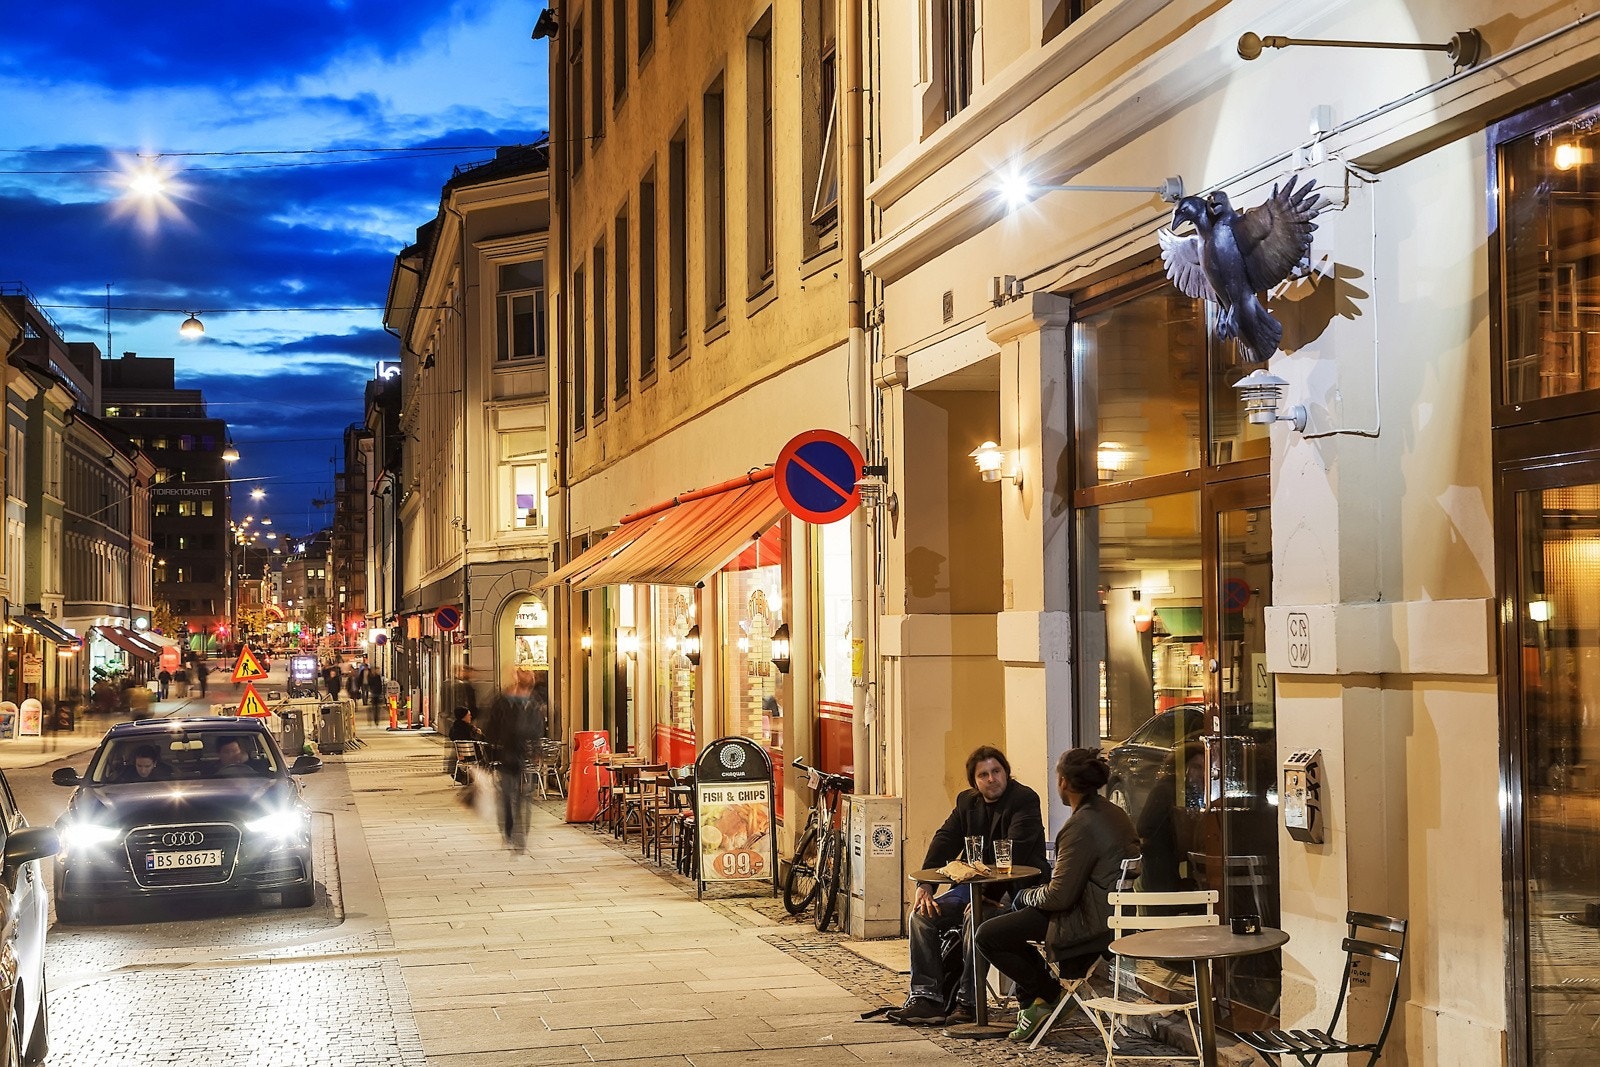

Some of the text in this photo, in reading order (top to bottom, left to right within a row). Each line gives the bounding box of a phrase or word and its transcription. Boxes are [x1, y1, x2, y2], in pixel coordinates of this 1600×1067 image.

[703, 789, 766, 803] FISH & CHIPS
[157, 852, 217, 867] BS 68673
